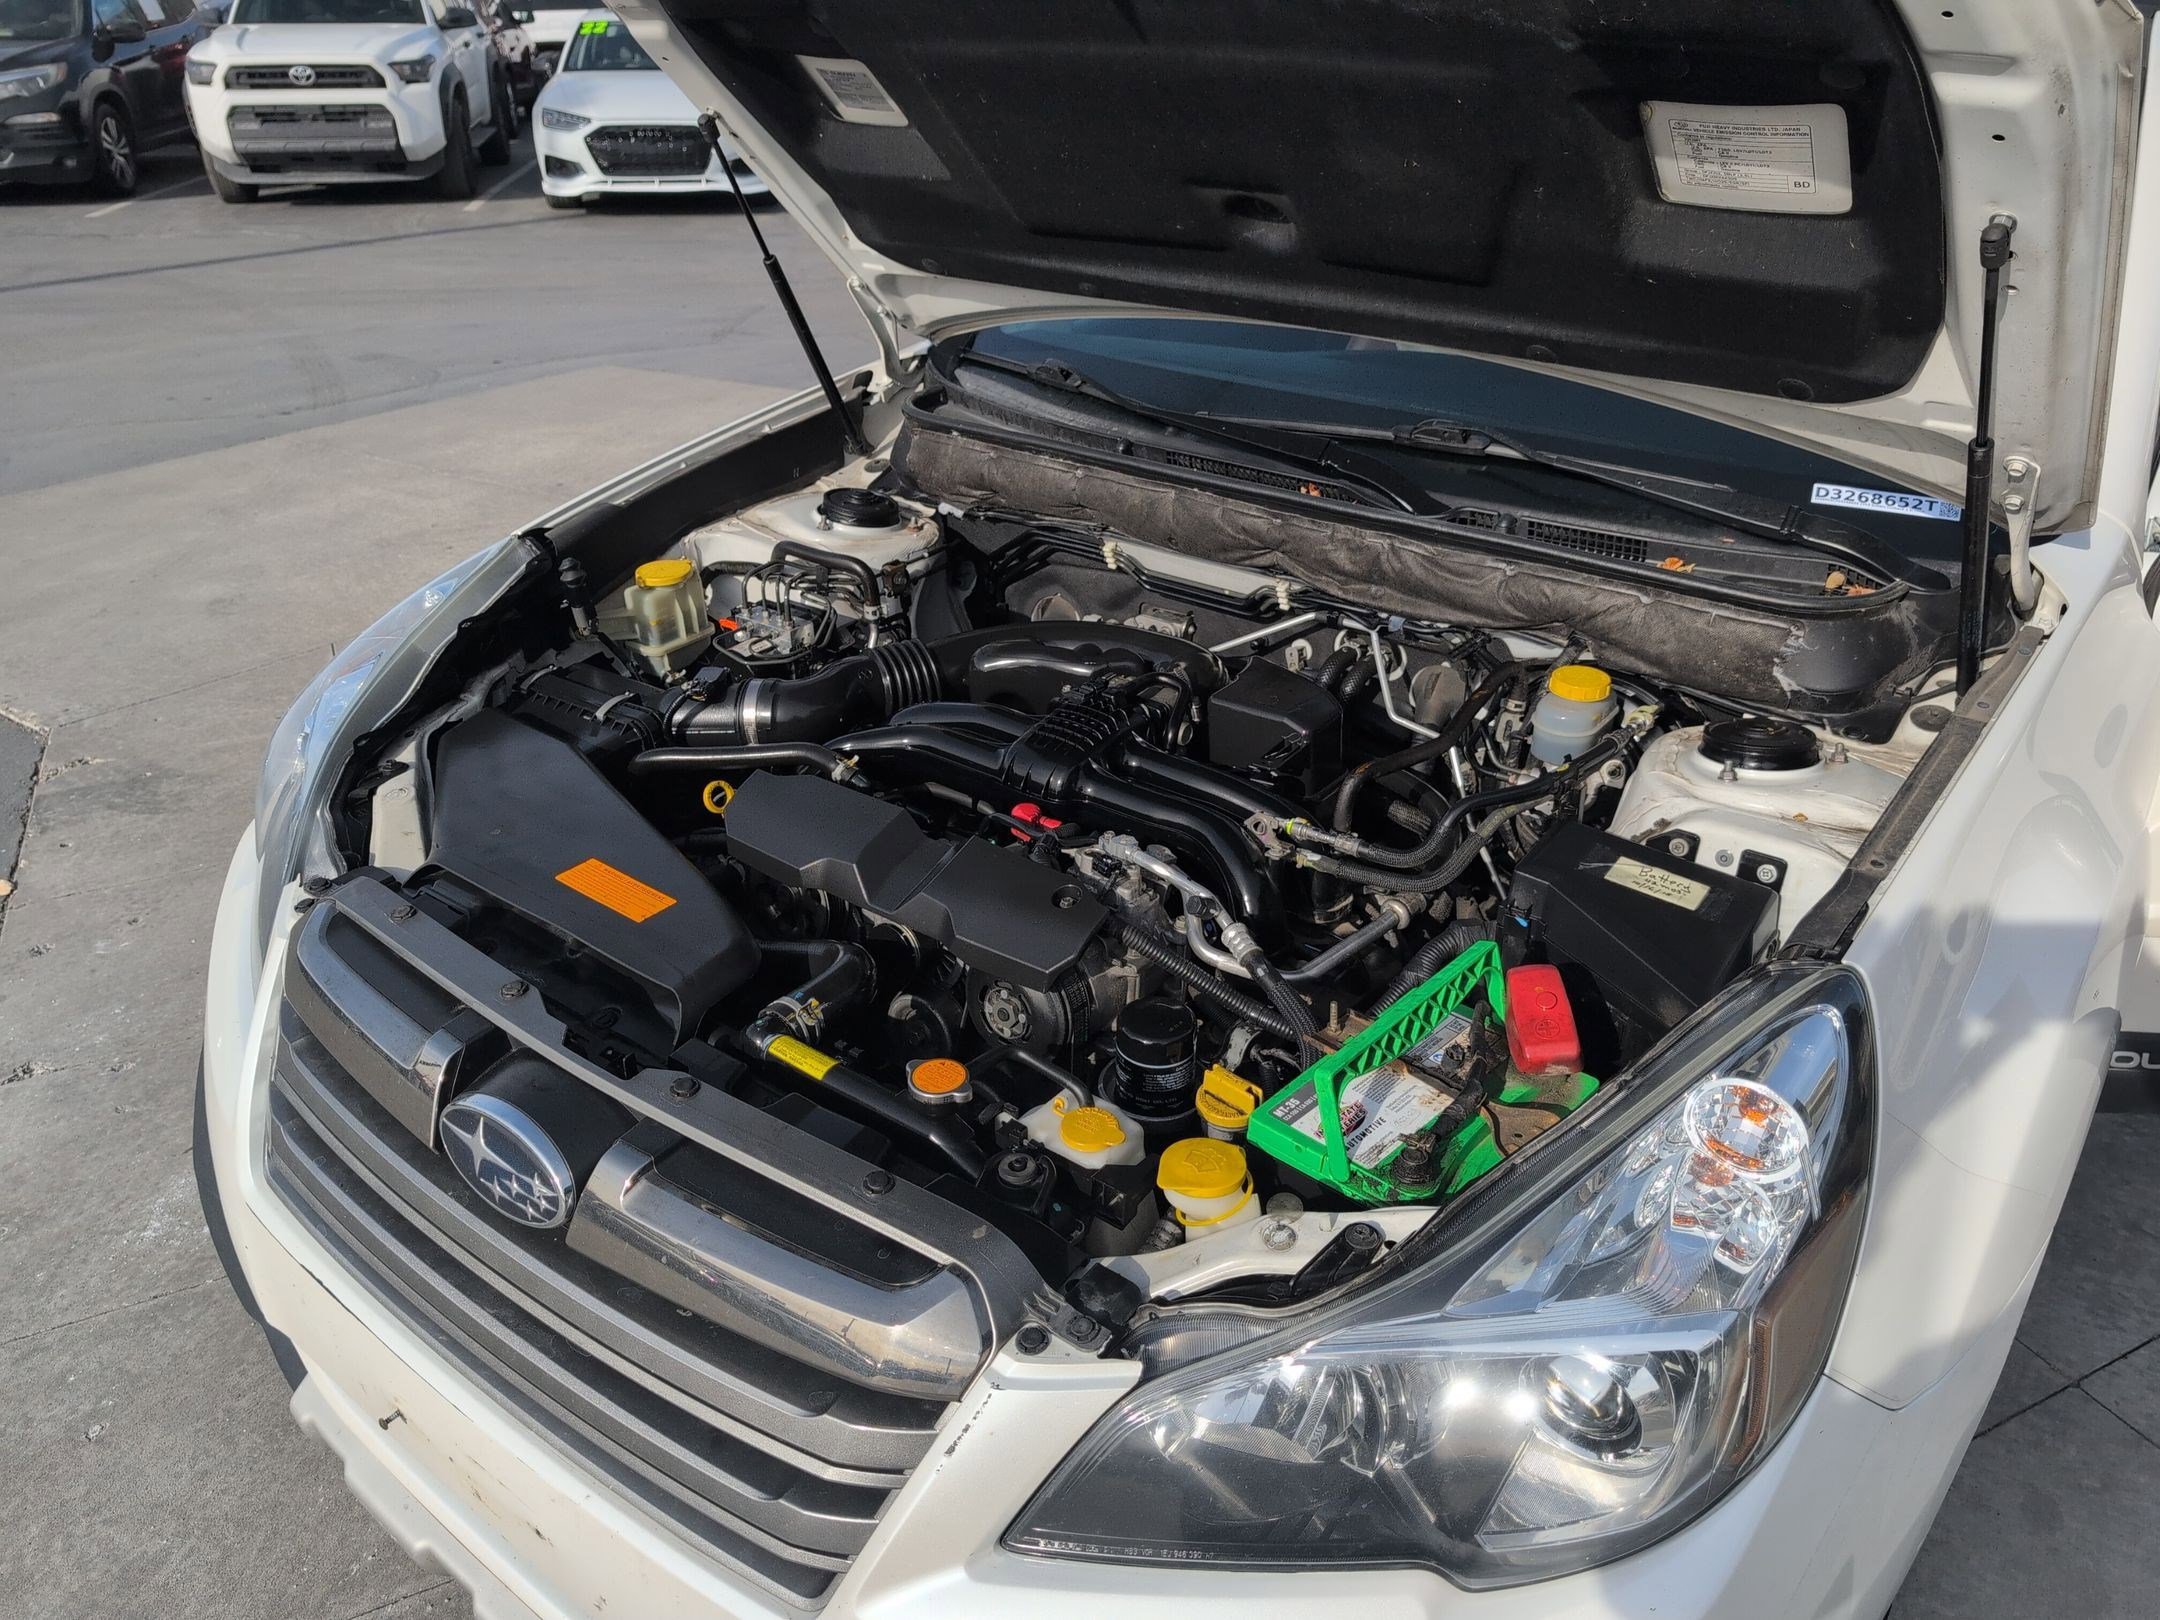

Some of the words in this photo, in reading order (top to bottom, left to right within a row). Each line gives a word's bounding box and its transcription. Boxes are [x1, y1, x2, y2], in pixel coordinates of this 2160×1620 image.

[580, 21, 608, 35] 22
[1794, 181, 1810, 189] BD
[1815, 486, 1939, 511] D3268652T
[1639, 866, 1691, 893] Battery
[1272, 1097, 1301, 1118] MT-35
